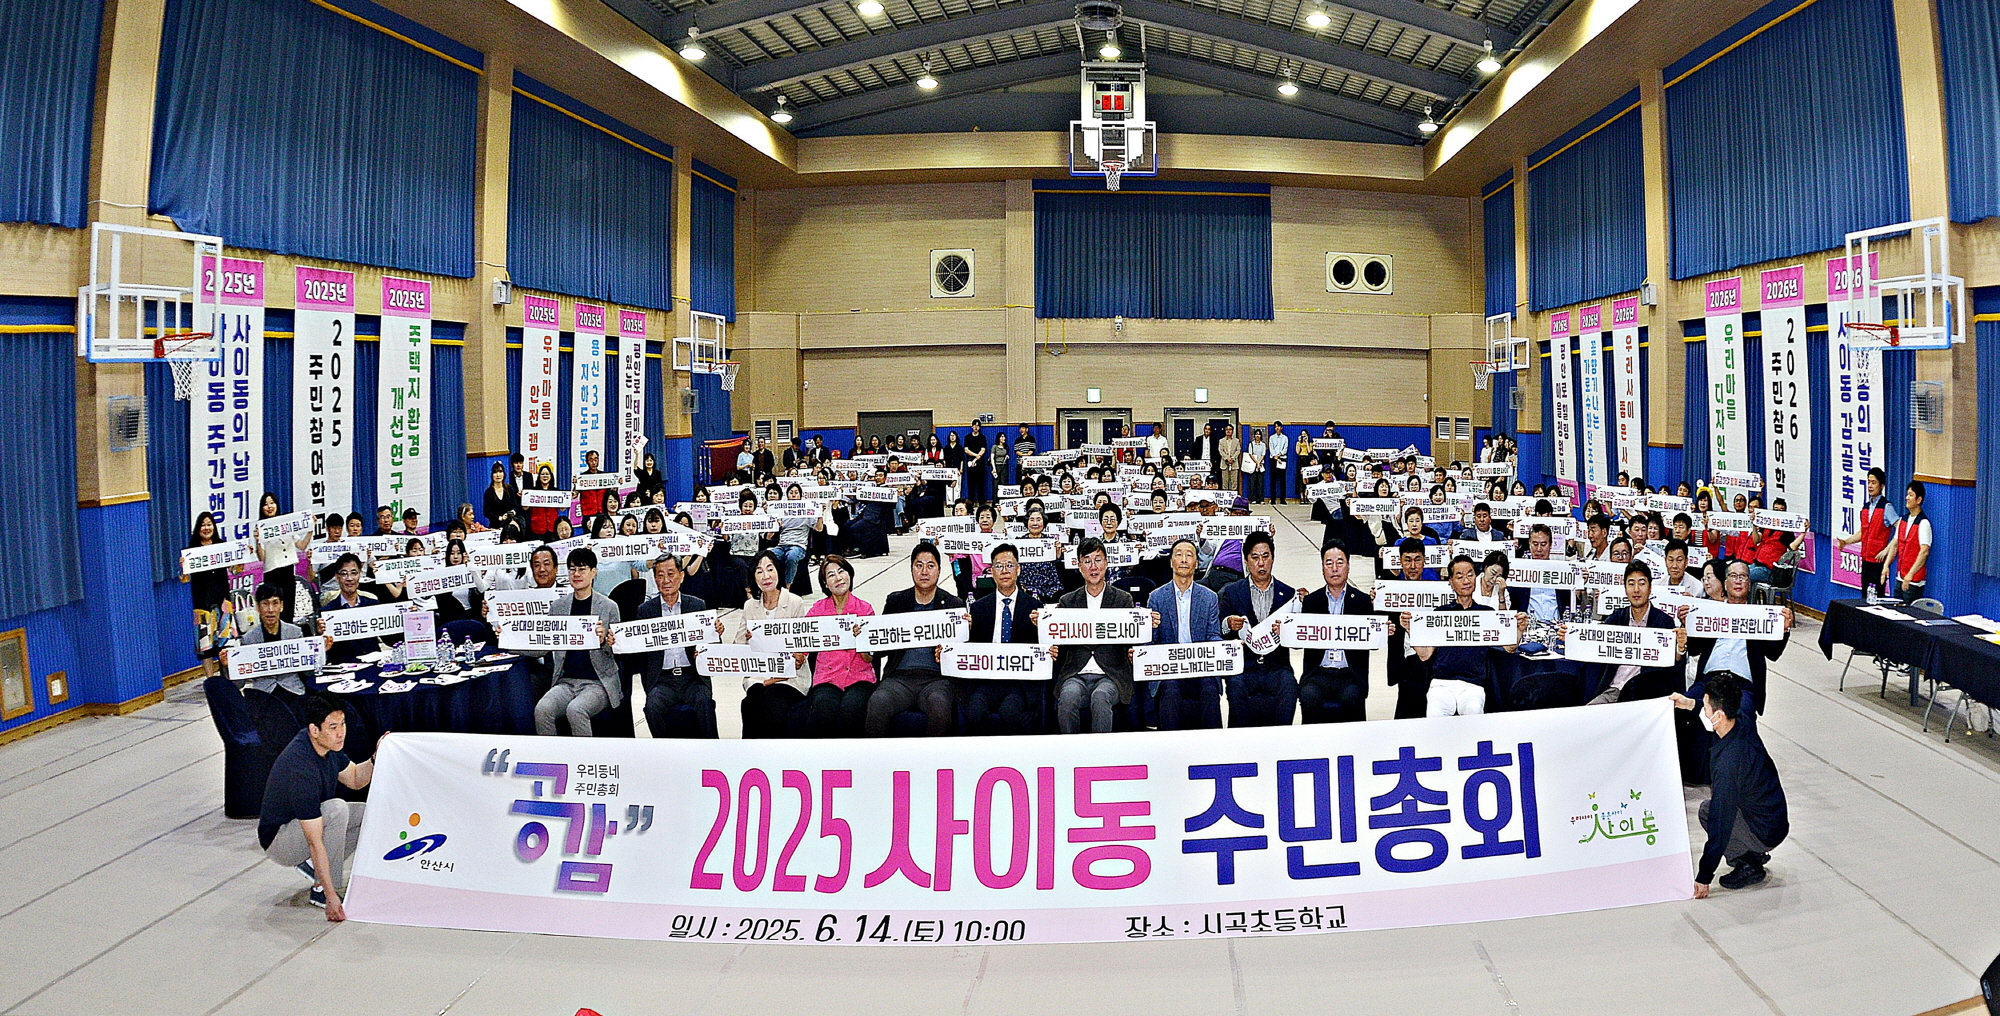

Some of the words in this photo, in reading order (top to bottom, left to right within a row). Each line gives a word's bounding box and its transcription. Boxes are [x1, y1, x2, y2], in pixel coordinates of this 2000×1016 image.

[304, 280, 347, 302] 2025년
[1766, 278, 1798, 300] 2026년
[389, 288, 425, 310] 2025년
[1710, 288, 1736, 308] 2026년
[529, 305, 556, 323] 2025년
[579, 312, 602, 328] 2025년
[1582, 314, 1599, 328] 2026년
[1615, 306, 1634, 322] 2026년
[623, 318, 642, 332] 2025년
[1552, 320, 1568, 333] 2026년
[232, 314, 250, 442] 사이동의
[542, 336, 552, 420] 우리마을
[1625, 335, 1634, 419] 우리사이
[1724, 324, 1736, 420] 우리마을
[1786, 318, 1798, 440] 2026
[330, 319, 342, 446] 2025
[528, 386, 540, 474] 안전캠페
[1772, 352, 1786, 501] 주민참여학
[1620, 400, 1628, 474] 좋은사
[390, 388, 404, 522] 개선연구회
[233, 452, 250, 482] 날
[1840, 412, 1854, 534] 감골축제
[207, 424, 226, 540] 주간행
[530, 495, 546, 504] 공감이
[1356, 504, 1374, 512] 공감하는
[1376, 503, 1395, 512] 우리사이
[1498, 508, 1511, 516] 이끄는
[263, 526, 280, 538] 공감은
[281, 524, 292, 534] 힘이
[292, 518, 310, 532] 됩니다
[926, 526, 946, 536] 공감으로
[1206, 526, 1226, 536] 공감은
[1228, 526, 1242, 536] 힘이
[600, 546, 624, 556] 공감이
[625, 543, 649, 555] 치유다
[680, 544, 690, 552] 공감
[944, 540, 970, 550] 공감하는
[1020, 546, 1044, 558] 치유다
[189, 556, 208, 569] 공감은
[210, 554, 224, 565] 힘이
[224, 550, 244, 563] 됩니다
[474, 555, 504, 566] 우리사이
[1840, 552, 1862, 574] 자치
[414, 578, 440, 594] 공감하면
[442, 572, 474, 588] 발전합니다
[1508, 569, 1540, 584] 우리사이
[1542, 570, 1576, 585] 좋은사이
[496, 601, 526, 616] 공감으로
[526, 600, 548, 615] 이끄는
[1384, 593, 1415, 608] 공감으로
[1416, 593, 1440, 608] 이끄는
[334, 619, 368, 636] 공감하는
[370, 614, 404, 632] 우리사이
[417, 622, 422, 630] 2
[512, 620, 534, 632] 상대의
[536, 619, 568, 632] 입장에서
[625, 626, 649, 638] 상대의
[650, 619, 684, 634] 입장에서
[764, 623, 790, 636] 말하지
[792, 621, 819, 634] 않아도
[1426, 615, 1452, 628] 말하지
[1454, 614, 1480, 628] 않아도
[1696, 616, 1730, 632] 공감하면
[1732, 618, 1774, 634] 발전합니다
[645, 636, 669, 648] 느끼는
[670, 631, 686, 643] 용기
[688, 629, 704, 642] 공감
[868, 626, 912, 646] 공감하는
[914, 622, 956, 640] 우리사이
[1048, 622, 1092, 639] 우리사이
[1095, 622, 1140, 640] 좋은사이
[1296, 626, 1332, 641] 공감이
[1334, 626, 1370, 642] 치유다
[1446, 630, 1480, 642] 느껴지는
[1482, 630, 1500, 642] 공감
[1579, 629, 1605, 643] 상대의
[1606, 631, 1641, 645] 입장에서
[528, 634, 552, 646] 느끼는
[552, 634, 568, 645] 용기
[569, 634, 584, 645] 공감
[785, 636, 820, 649] 느껴지는
[823, 635, 840, 647] 공감
[258, 647, 282, 658] 정답이
[284, 643, 300, 656] 아닌
[1168, 648, 1196, 660] 정답이
[1198, 646, 1216, 658] 아닌
[1598, 646, 1623, 659] 느끼는
[1624, 648, 1642, 660] 용기
[1642, 648, 1660, 661] 공감
[238, 662, 268, 676] 공감으로
[270, 657, 300, 670] 느껴지는
[707, 658, 739, 673] 공감으로
[741, 657, 766, 673] 이끄는
[768, 657, 785, 674] 마을
[956, 654, 994, 671] 공감이
[996, 655, 1034, 672] 치유다
[1144, 663, 1179, 676] 공감으로
[1180, 661, 1214, 674] 느껴지는
[1216, 660, 1234, 671] 마을
[576, 764, 620, 780] 우리동네
[574, 783, 620, 797] 주민총회
[689, 767, 852, 894] 2025
[864, 764, 1156, 892] 사이동
[1182, 740, 1542, 886] 주민총회
[420, 860, 454, 872] 안산시
[669, 914, 717, 940] 일시
[738, 918, 804, 940] 2025.
[815, 914, 841, 940] 6.
[954, 920, 1026, 941] 10:00
[1125, 914, 1174, 938] 장소
[1198, 905, 1348, 934] 시곡초등학교
